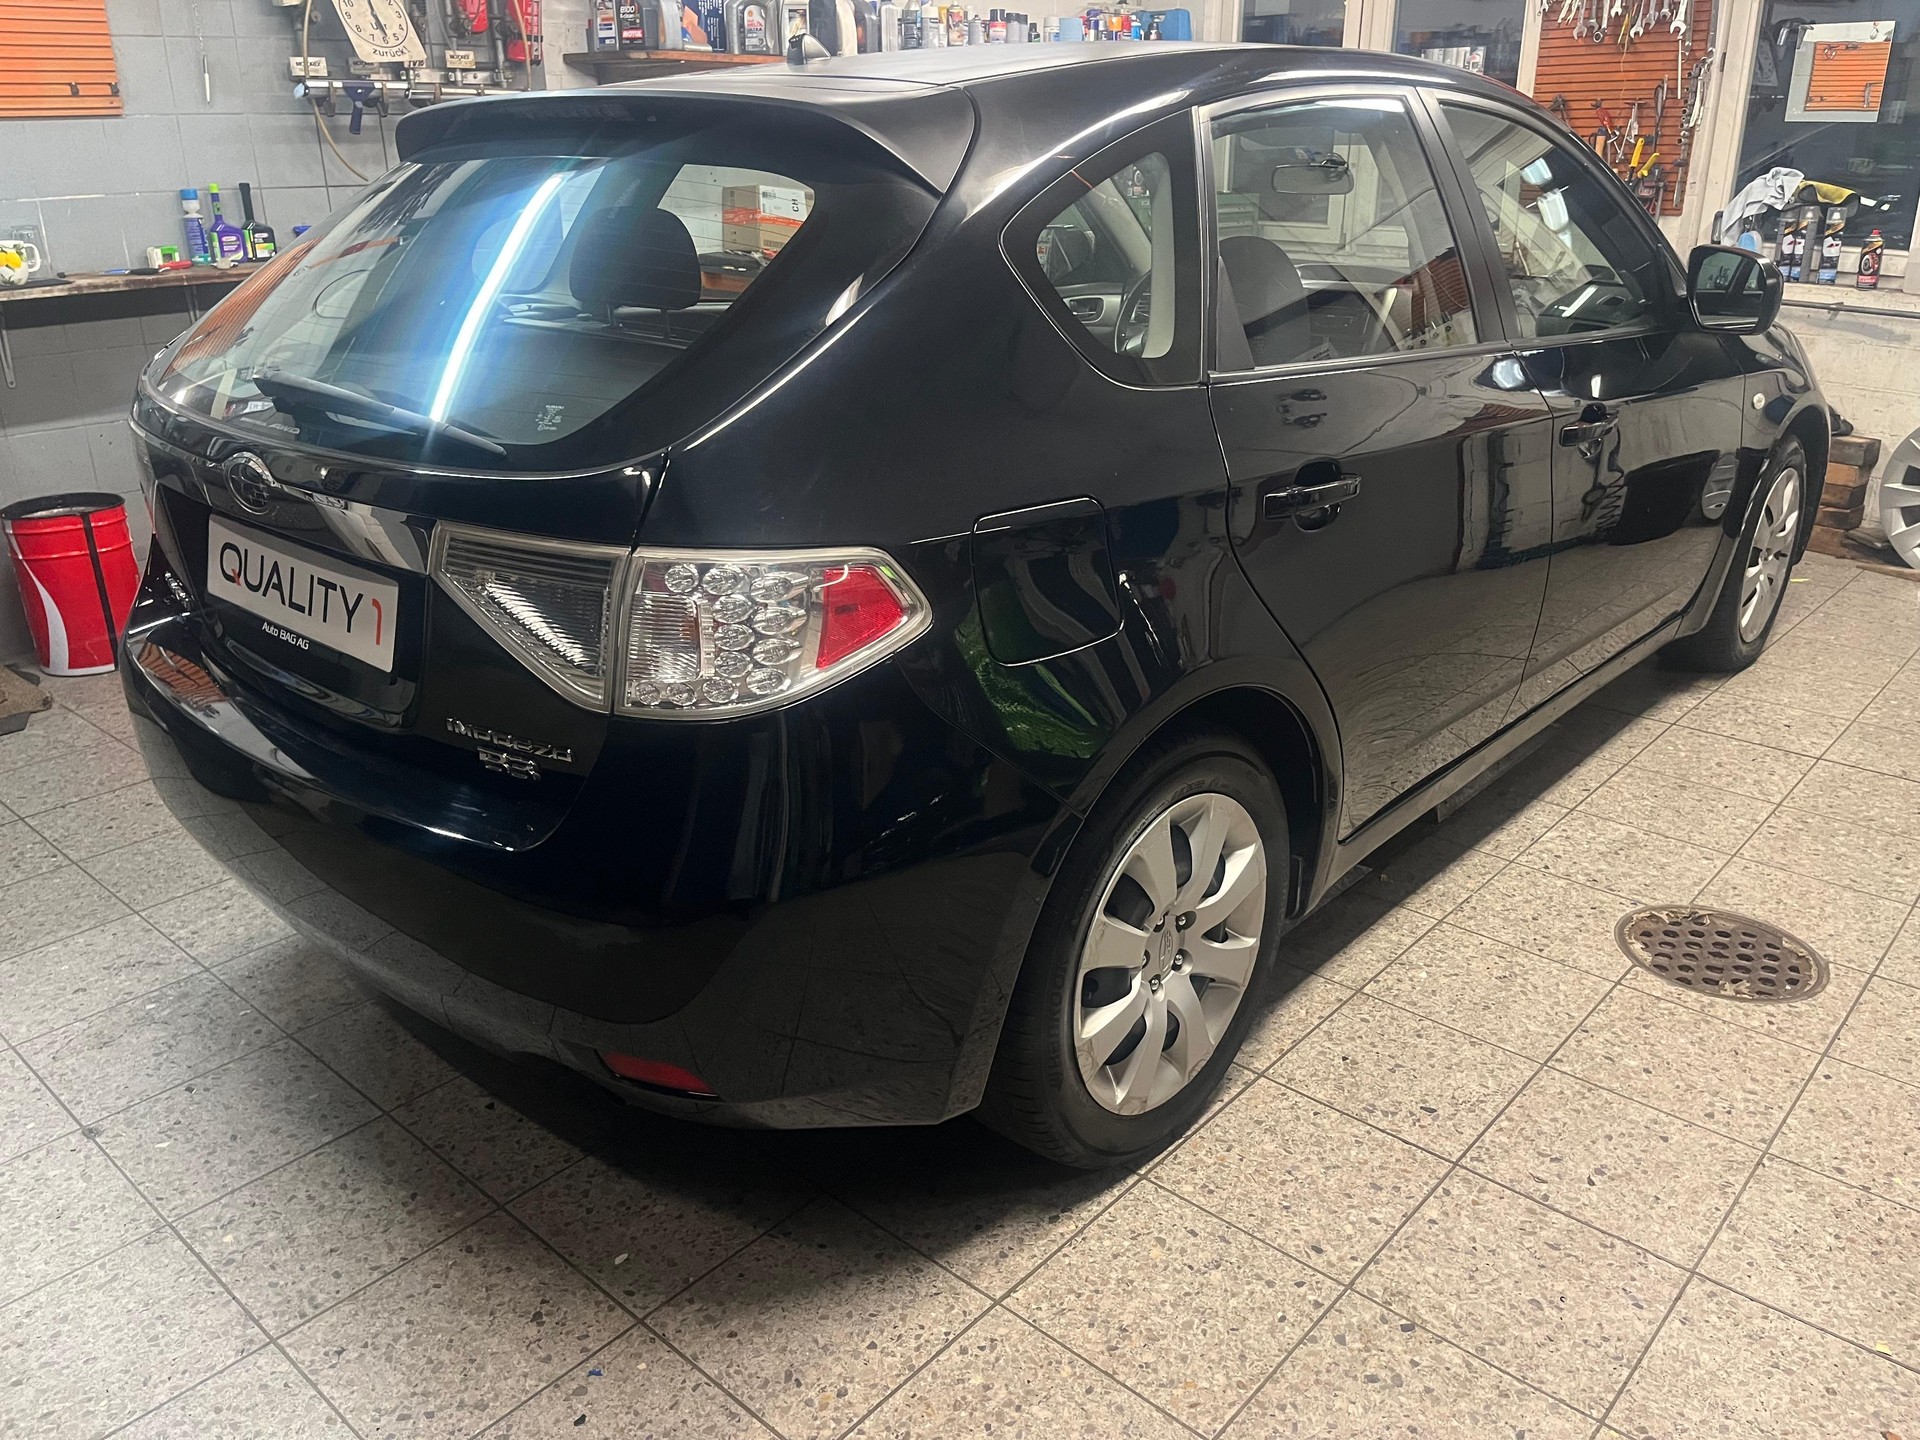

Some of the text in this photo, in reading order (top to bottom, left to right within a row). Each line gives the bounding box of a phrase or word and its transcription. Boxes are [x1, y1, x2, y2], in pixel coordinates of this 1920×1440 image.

[345, 12, 352, 20] 9
[395, 11, 402, 19] 3
[355, 24, 362, 33] 8
[370, 22, 388, 31] Ur
[398, 24, 405, 32] 4
[369, 34, 375, 42] 7
[392, 33, 400, 41] 5
[622, 30, 643, 38] MOTUL
[382, 36, 389, 44] 6
[372, 45, 410, 58] zurück!
[791, 198, 800, 213] CH
[219, 541, 382, 646] QUALITY 1
[262, 621, 310, 650] Auto BAG AG
